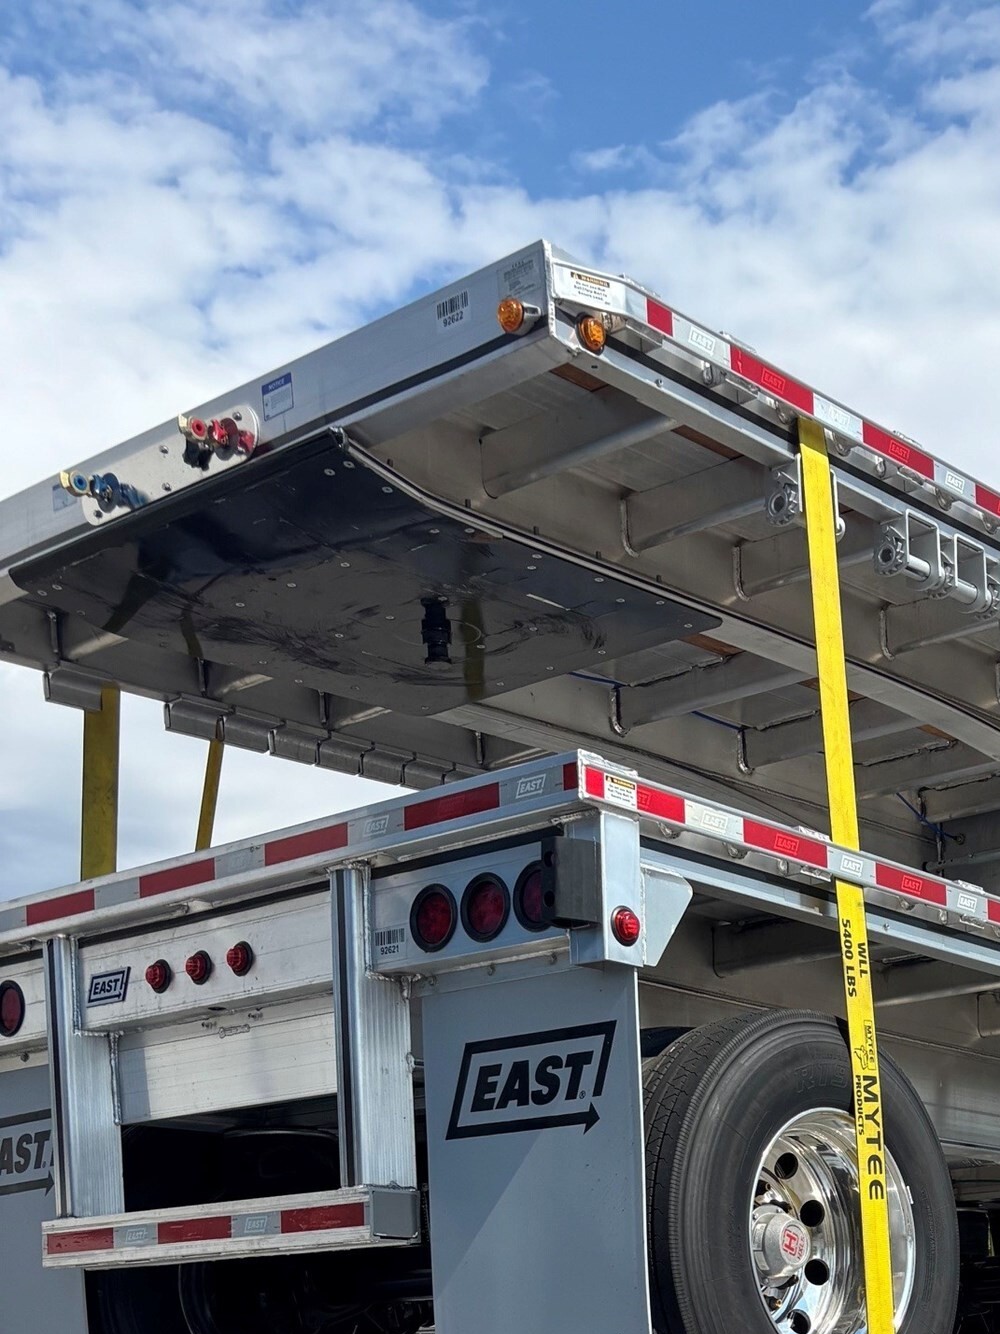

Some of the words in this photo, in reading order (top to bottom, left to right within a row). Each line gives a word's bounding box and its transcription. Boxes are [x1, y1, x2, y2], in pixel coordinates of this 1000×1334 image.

[443, 311, 464, 327] 92622
[692, 330, 714, 351] EAST
[764, 371, 784, 390] EAST
[891, 442, 909, 459] EAST
[519, 777, 542, 793] EAST
[366, 817, 386, 833] EAST
[703, 812, 726, 828] EAST
[777, 837, 797, 851] EAST
[843, 857, 862, 873] EAST
[903, 877, 921, 892] EAST
[959, 896, 977, 910] EAST
[842, 918, 853, 960] 5400
[380, 944, 400, 956] 92621
[858, 943, 868, 978] WLL
[93, 977, 121, 995] EAST
[846, 966, 857, 997] LBS
[470, 1050, 594, 1113] EAST
[856, 1075, 865, 1136] PRODUCTS
[863, 1075, 884, 1200] MYTEE
[247, 1217, 266, 1230] EAST
